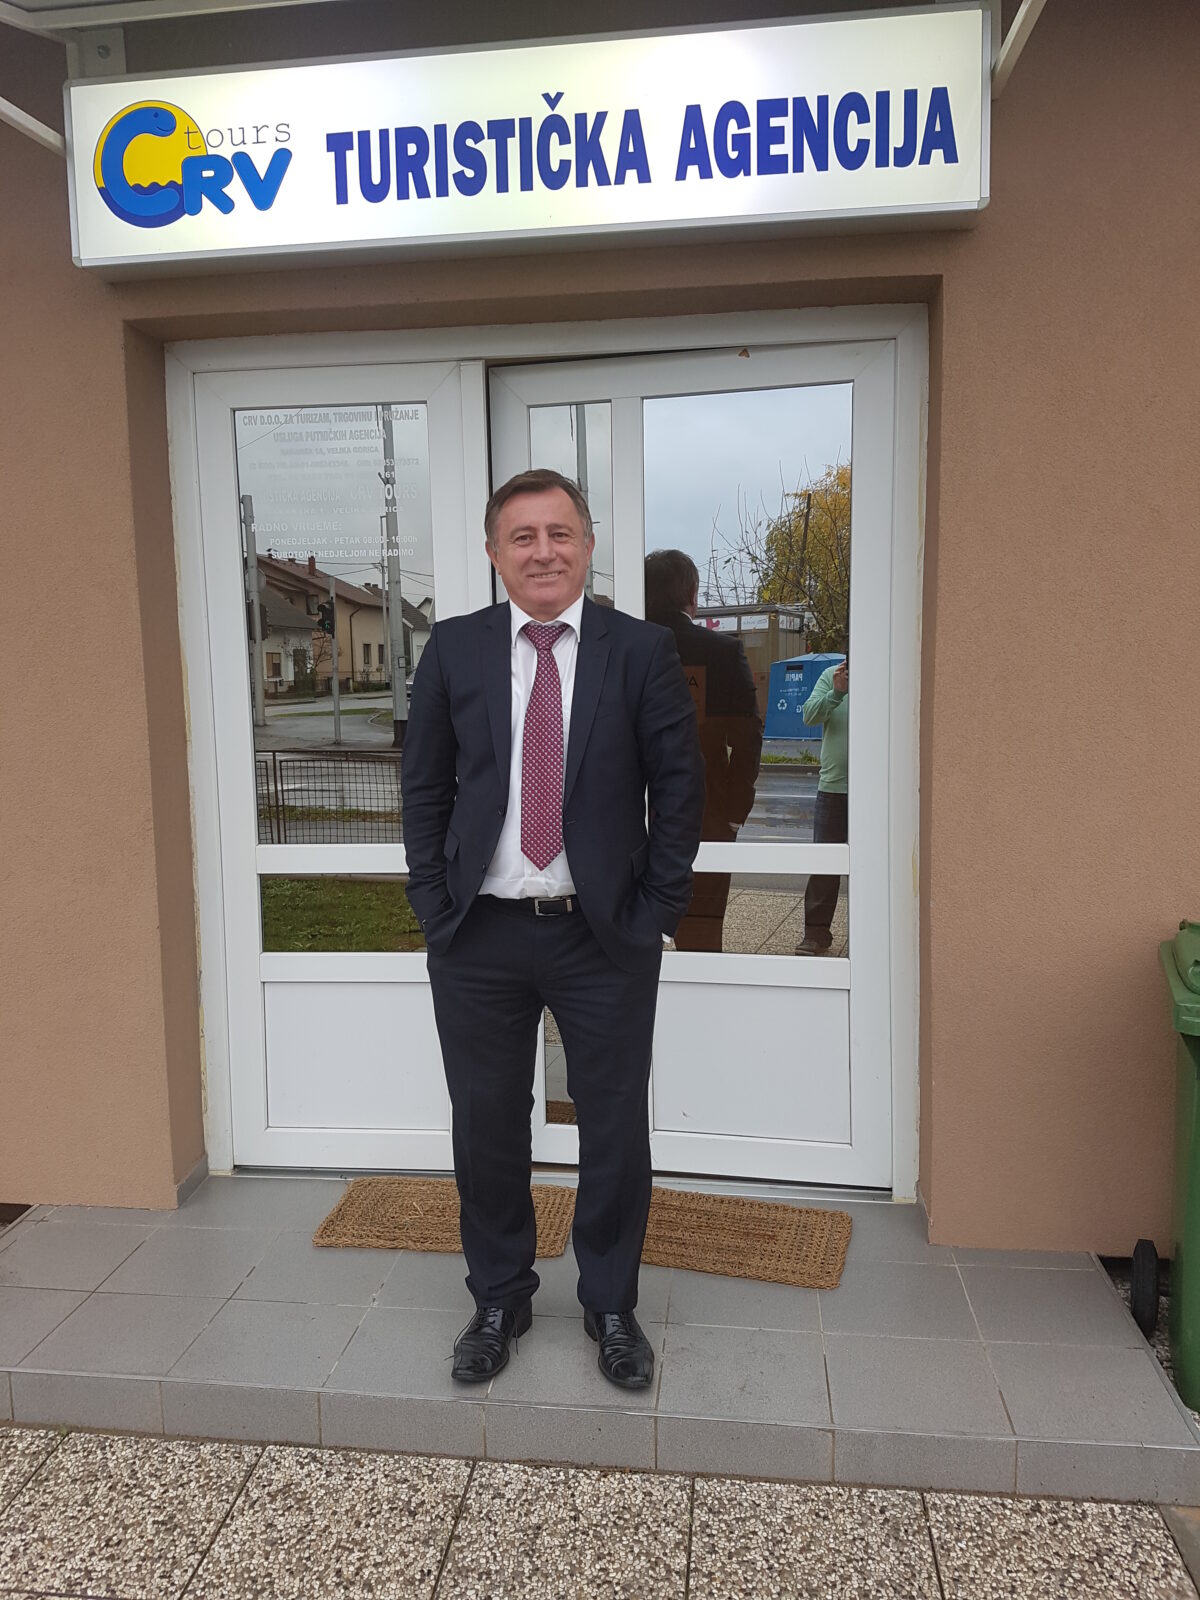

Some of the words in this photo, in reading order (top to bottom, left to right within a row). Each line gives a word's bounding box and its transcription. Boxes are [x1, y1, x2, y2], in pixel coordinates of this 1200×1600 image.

[184, 122, 291, 150] tours
[326, 92, 652, 205] TURISTIČKA
[675, 86, 959, 181] AGENCIJA
[242, 415, 258, 427] CRV
[283, 413, 295, 425] ZA
[333, 410, 373, 423] TRGOVINU
[273, 431, 304, 443] USLUGA
[305, 427, 347, 442] PUTNIČKIH
[348, 428, 387, 441] AGENCIJA
[251, 522, 289, 533] RADNO
[269, 536, 327, 546] PONEDJELJAK
[334, 536, 361, 545] PETAK
[271, 550, 311, 559] SUBOTOM
[318, 548, 367, 558] NEDJELJOM
[368, 548, 380, 557] NE
[381, 547, 414, 557] RADIMO
